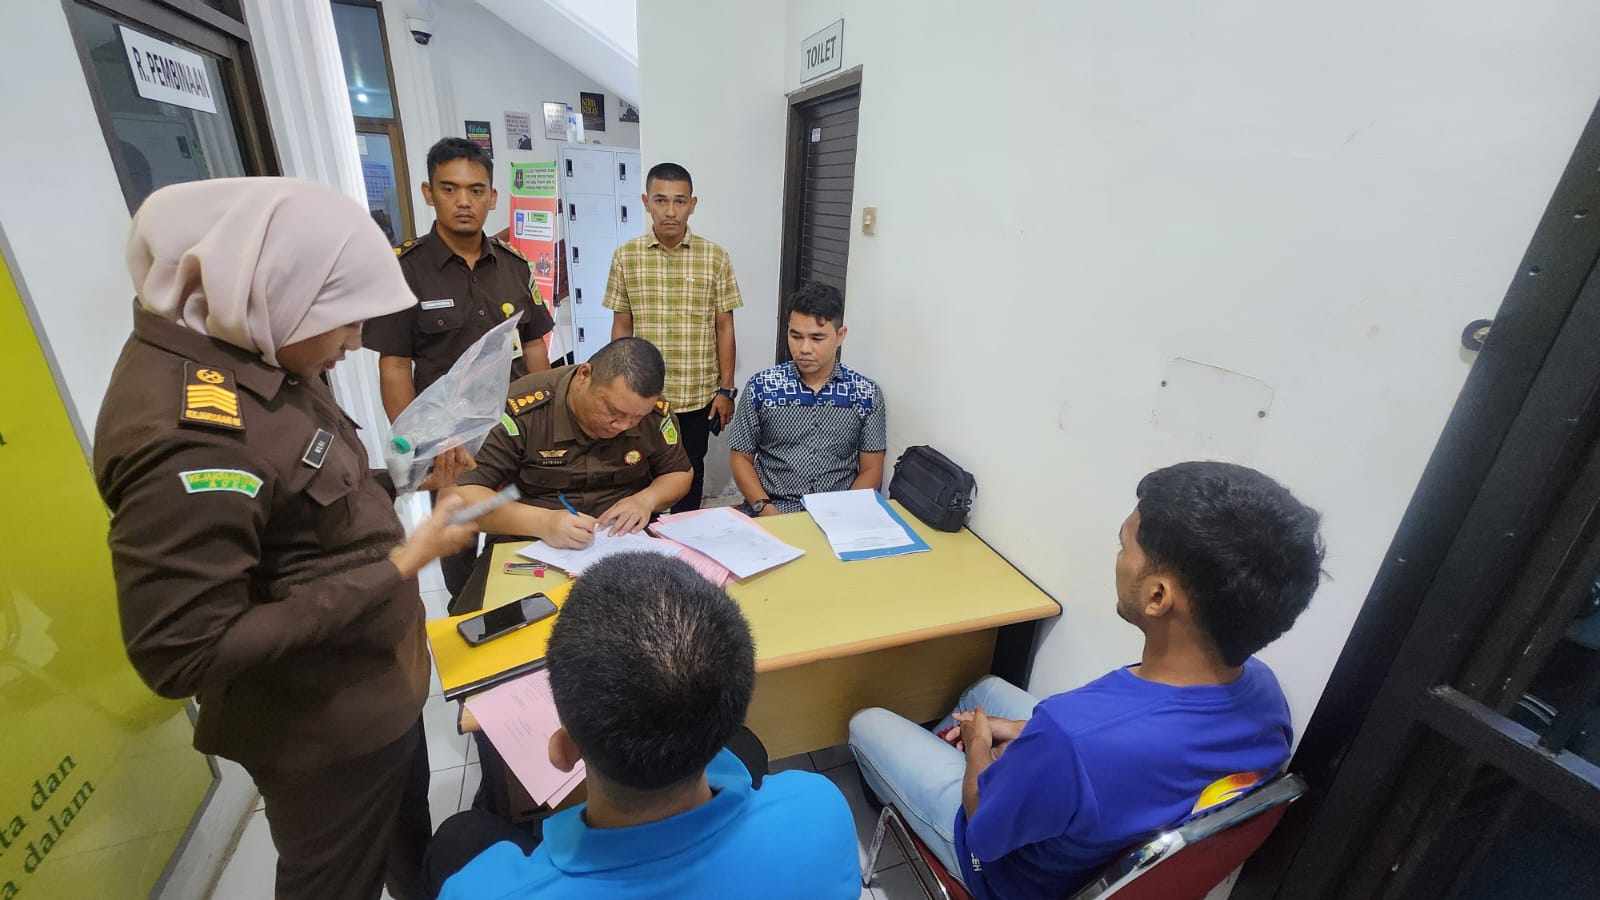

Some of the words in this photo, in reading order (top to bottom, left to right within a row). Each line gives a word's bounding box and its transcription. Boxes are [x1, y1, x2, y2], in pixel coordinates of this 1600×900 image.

[131, 46, 152, 82] R.
[146, 51, 210, 98] PEMBINAAN
[806, 35, 837, 70] TOILET
[0, 815, 27, 856] ta
[31, 755, 77, 811] dan
[24, 781, 95, 873] dalam
